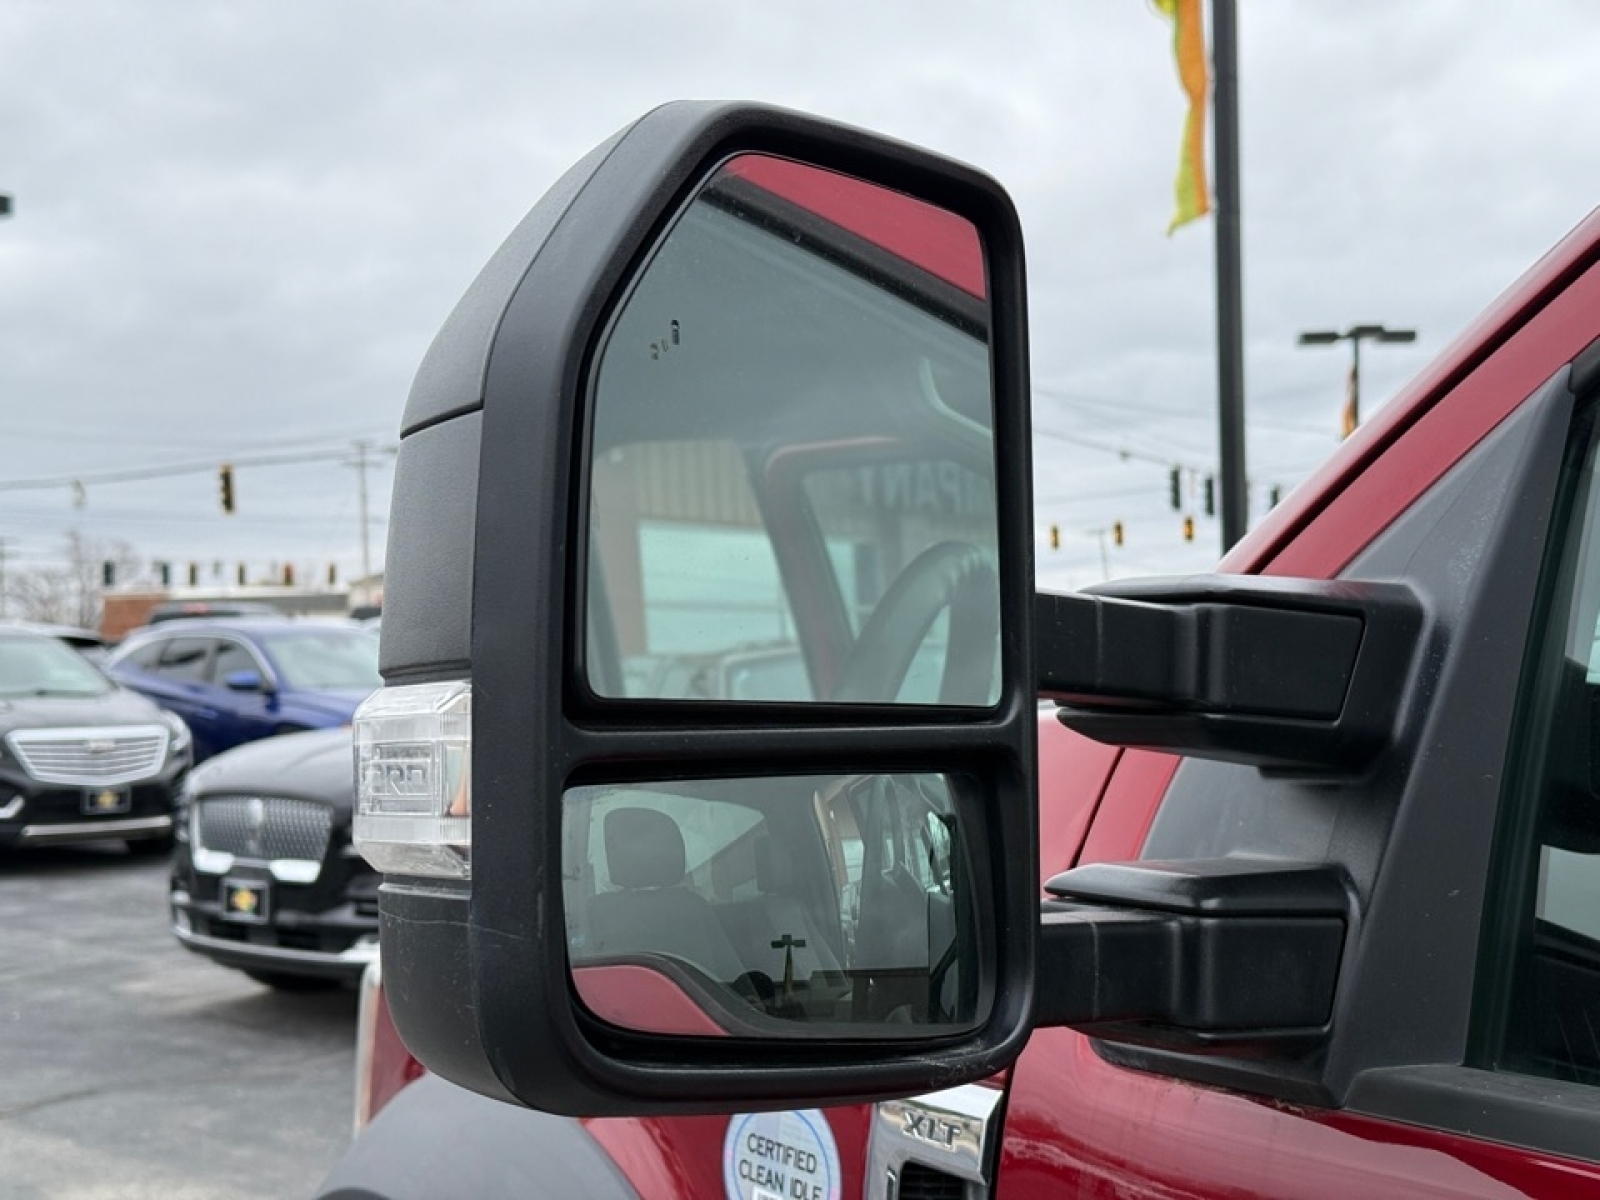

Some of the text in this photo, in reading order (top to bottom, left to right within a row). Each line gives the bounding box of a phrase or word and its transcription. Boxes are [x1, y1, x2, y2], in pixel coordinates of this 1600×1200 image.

[903, 1111, 962, 1151] XLT
[747, 1132, 817, 1174] CERTIFIED
[739, 1159, 785, 1193] CLEAN
